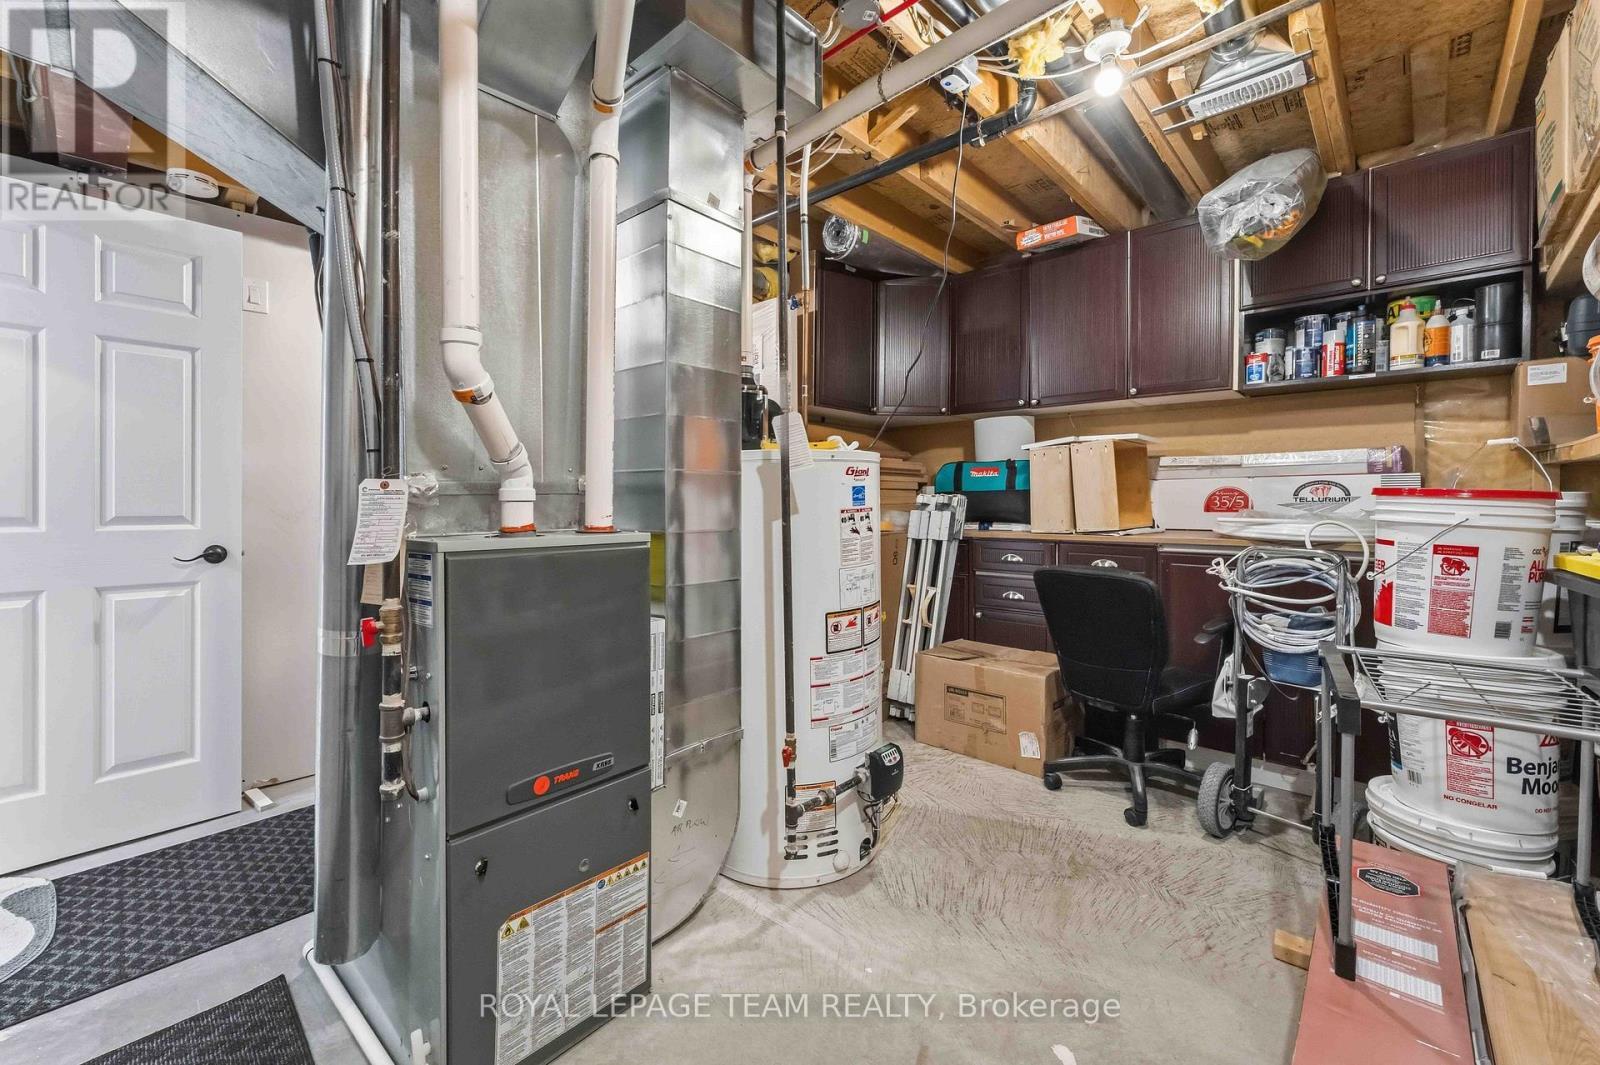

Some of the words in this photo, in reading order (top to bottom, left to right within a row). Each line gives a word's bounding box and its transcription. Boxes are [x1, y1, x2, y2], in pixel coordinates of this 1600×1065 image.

[845, 466, 870, 477] Giant
[970, 469, 999, 478] makita
[1211, 495, 1245, 509] 35/5
[1530, 560, 1544, 572] ALL
[1506, 756, 1559, 780] Benja
[1521, 778, 1559, 796] Moo
[1455, 796, 1498, 810] CONGELAR
